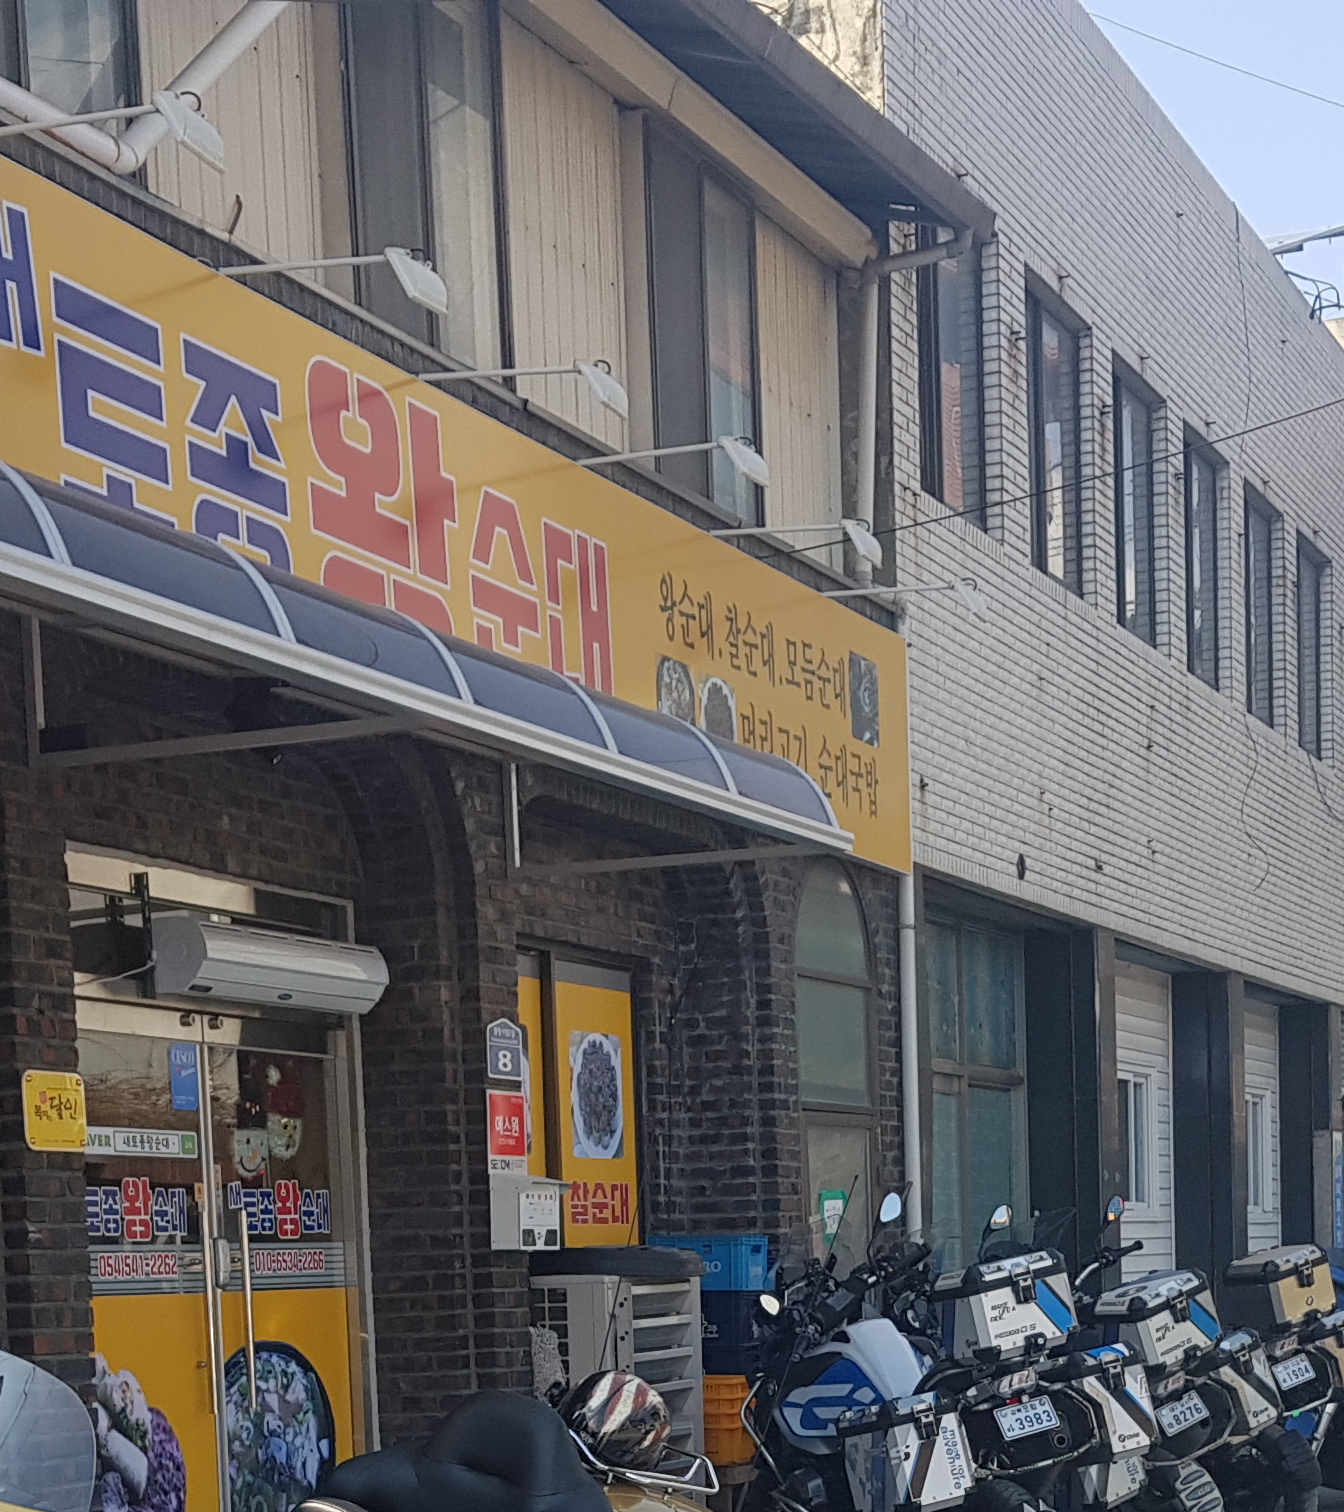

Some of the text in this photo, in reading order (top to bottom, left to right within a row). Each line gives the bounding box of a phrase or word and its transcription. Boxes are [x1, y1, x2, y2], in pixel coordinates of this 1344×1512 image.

[817, 734, 879, 819] 순대국밥
[497, 1050, 513, 1072] 8
[569, 1180, 631, 1225] 찰순대
[254, 1249, 325, 1274] 010-6534-2266
[1014, 1409, 1053, 1431] 3983
[1172, 1402, 1203, 1426] 8276
